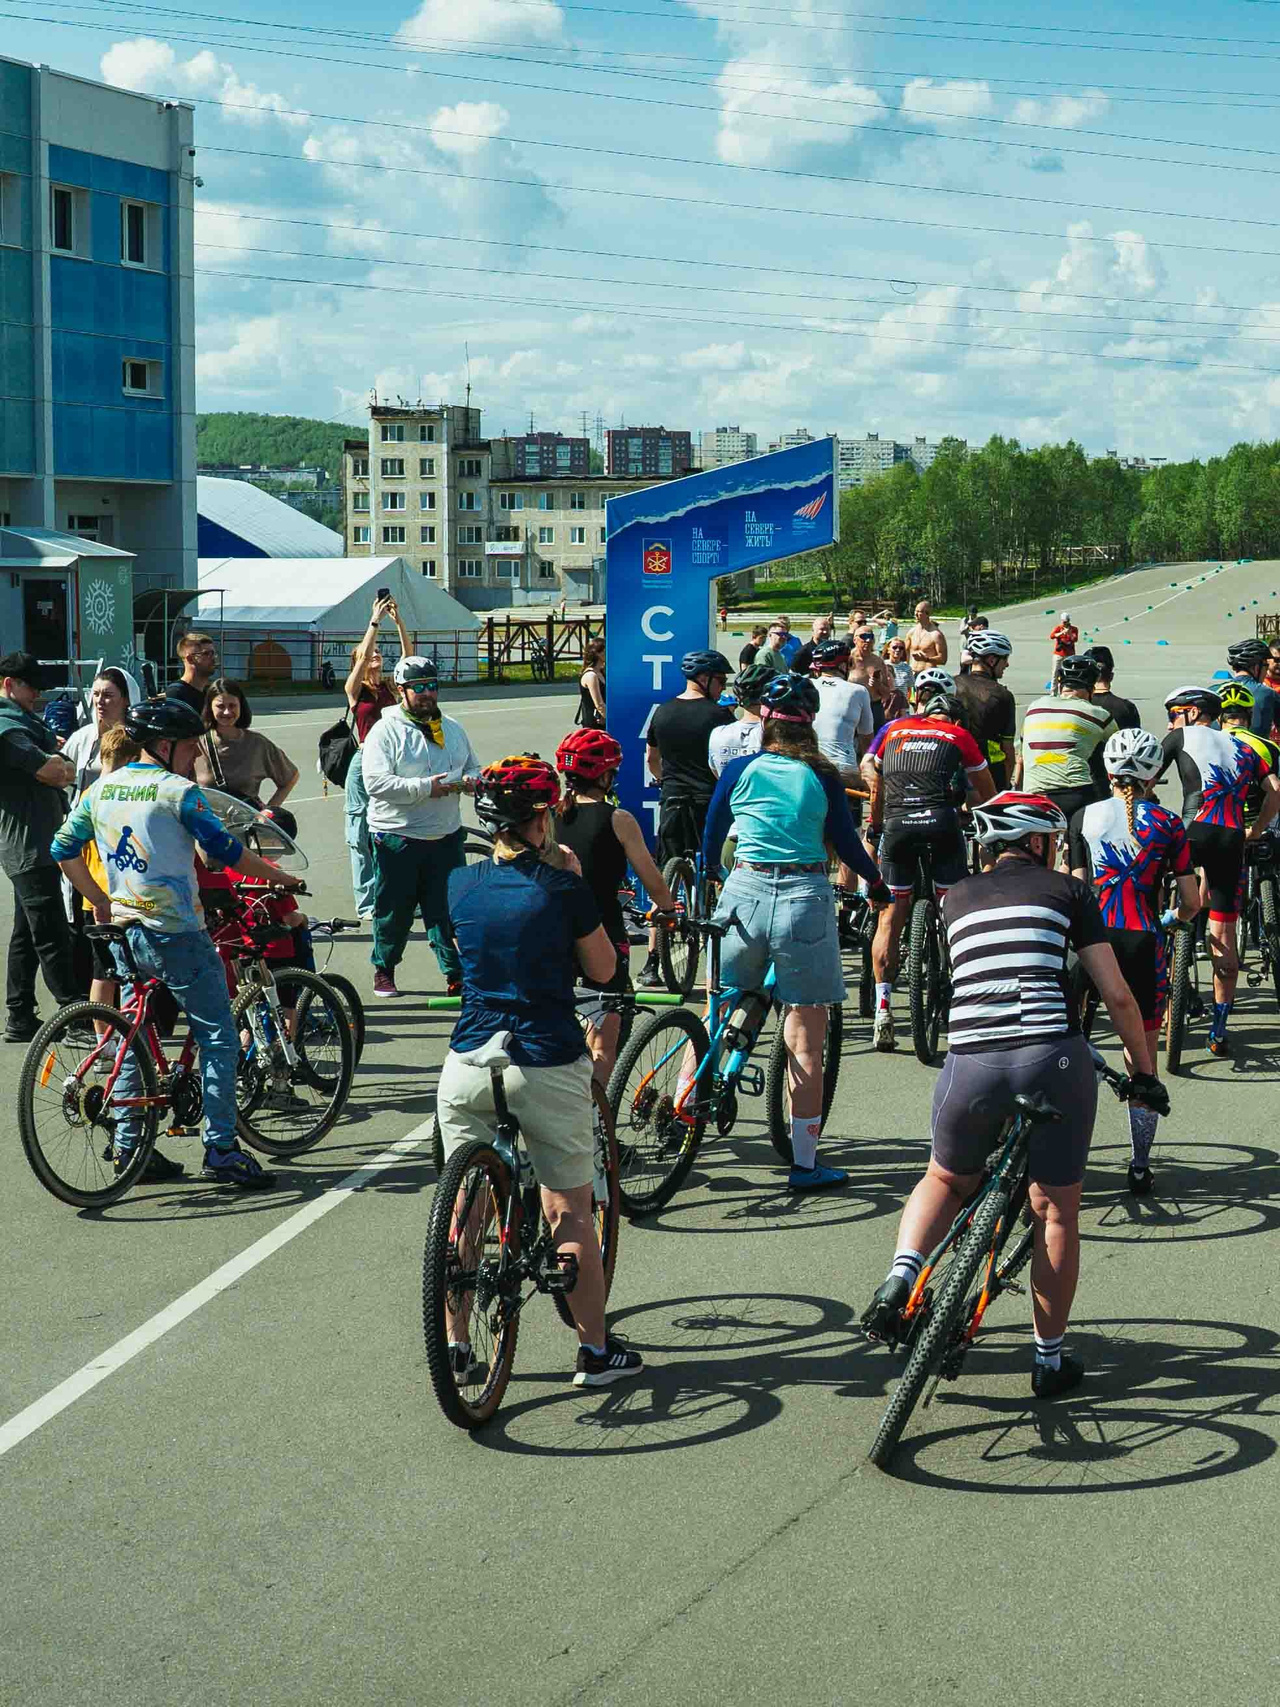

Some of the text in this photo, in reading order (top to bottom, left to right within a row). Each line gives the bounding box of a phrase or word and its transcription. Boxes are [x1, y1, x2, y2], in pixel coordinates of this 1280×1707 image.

[745, 510, 757, 523] НА
[692, 527, 703, 539] НА
[745, 536, 773, 547] ЖИТЬ!
[692, 551, 720, 564] СПОРТ!
